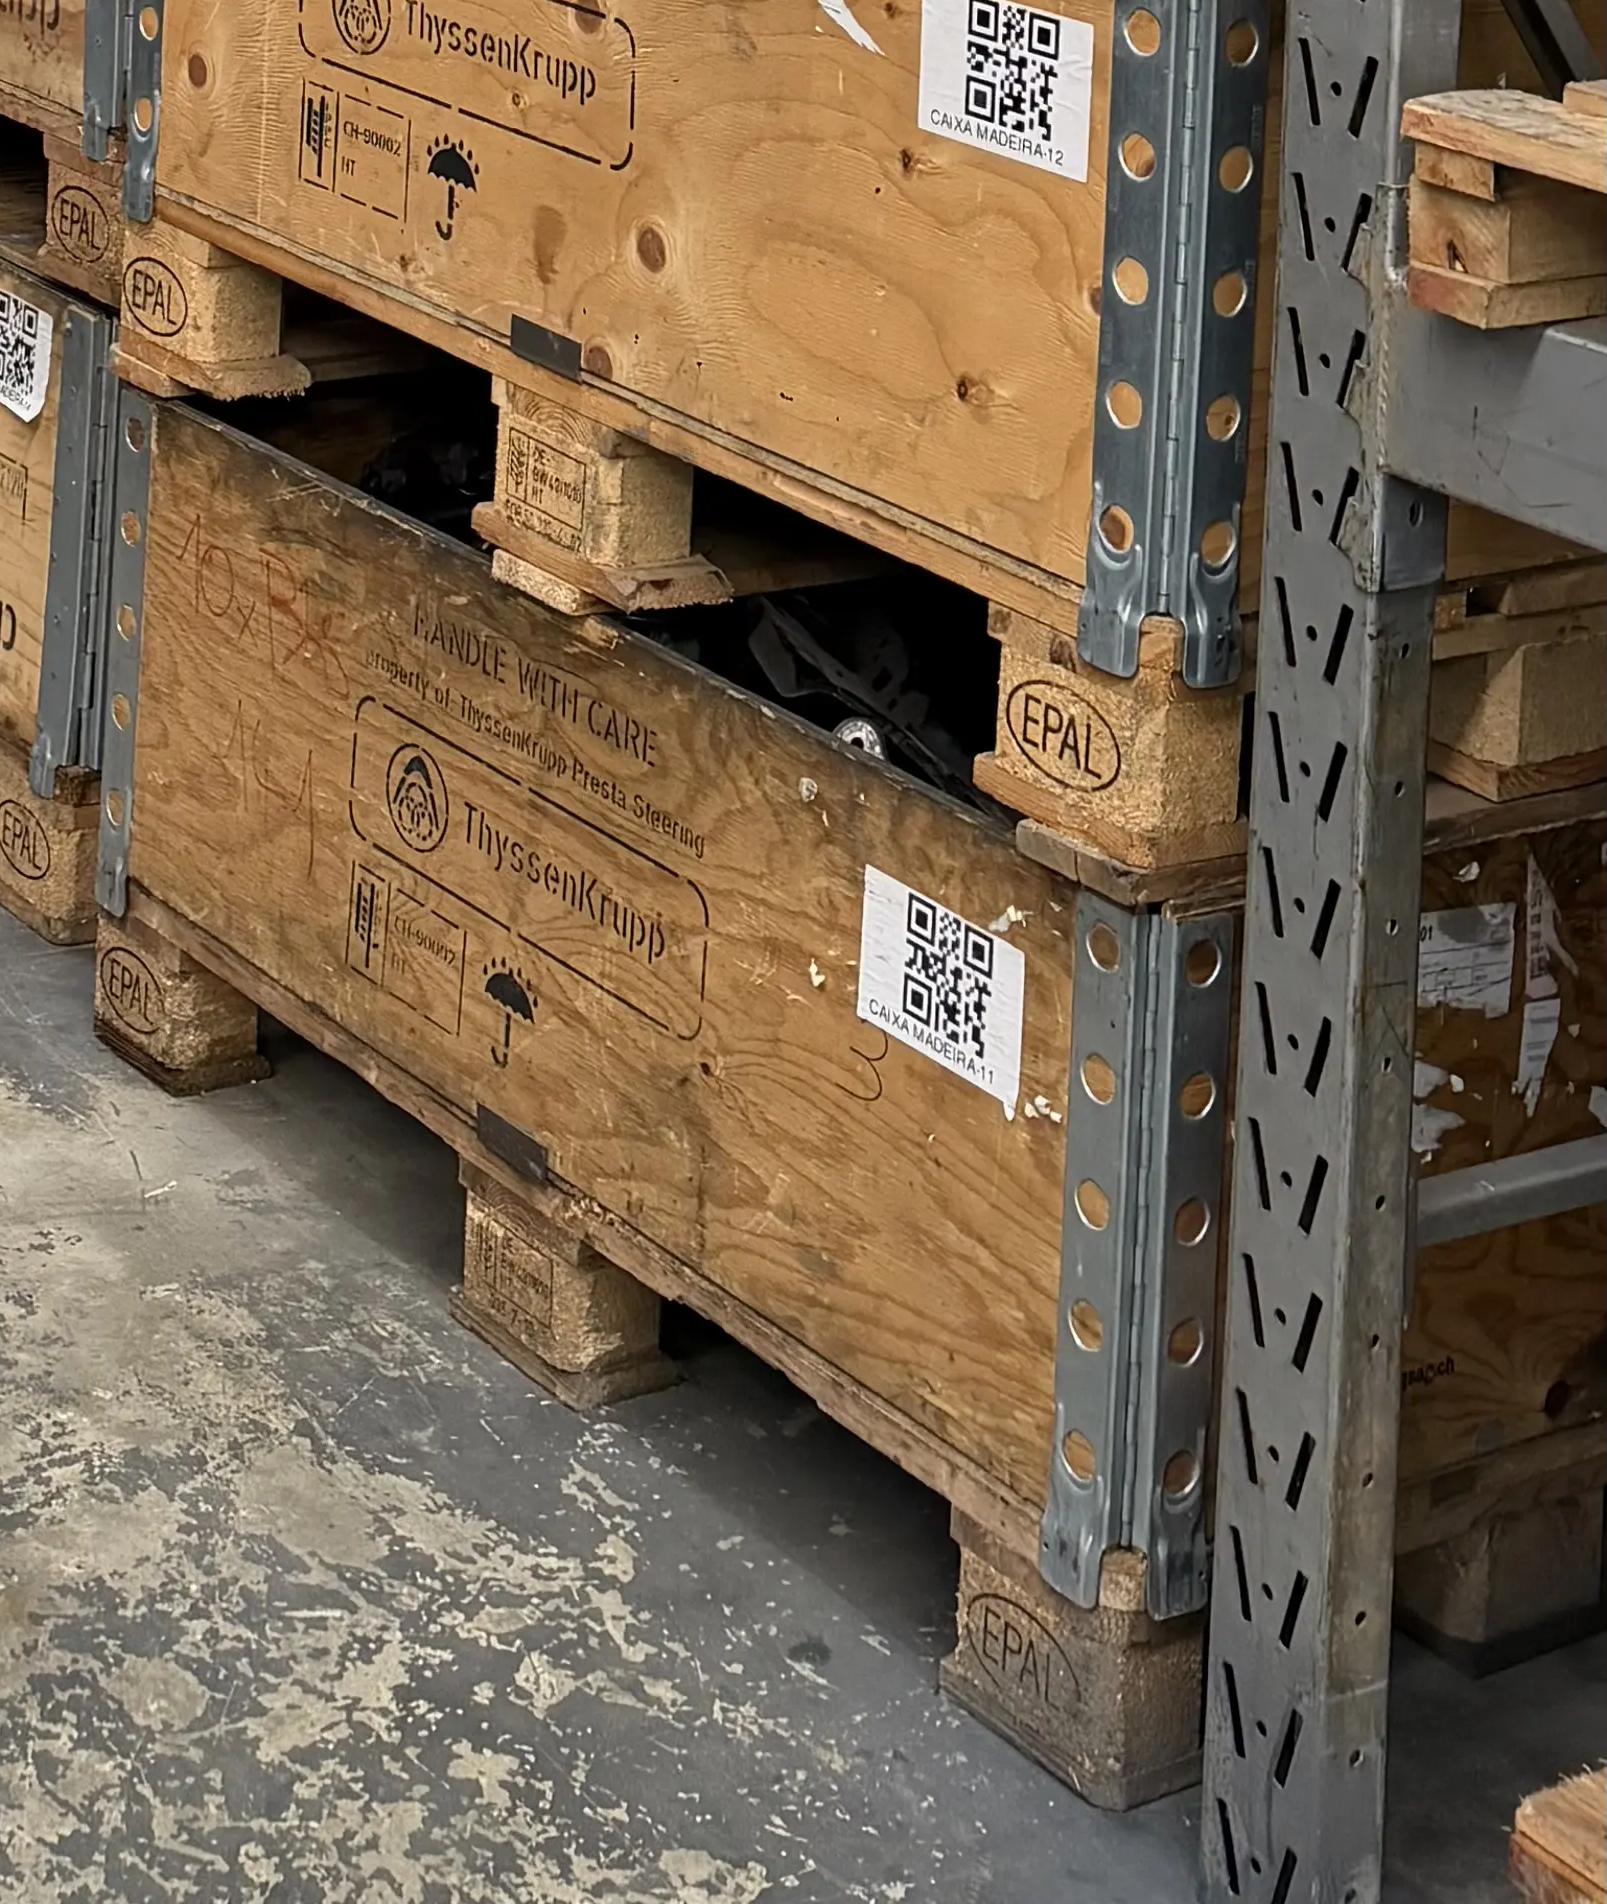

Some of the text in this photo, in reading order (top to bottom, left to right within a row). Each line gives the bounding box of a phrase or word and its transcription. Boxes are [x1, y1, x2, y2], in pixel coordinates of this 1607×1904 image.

[340, 154, 357, 178] HT
[342, 119, 402, 158] CH-90002
[930, 108, 1065, 167] CAIXA MADEIRA-12
[59, 199, 101, 252] EPAL
[132, 267, 178, 326] EPAL
[412, 614, 508, 685] HANDLE
[517, 656, 580, 725] WITH
[586, 699, 658, 769] CARE
[363, 651, 429, 705] property
[459, 691, 567, 780] ThyssenKrupp
[572, 757, 628, 812] Presta
[633, 793, 707, 860] Steering
[1022, 692, 1102, 780] EPAL
[2, 809, 42, 872] EPAL
[464, 801, 667, 964] ThyssenKrupp
[109, 957, 154, 1026] EPAL
[868, 997, 995, 1085] CAIXA MADEIRA-11
[982, 1604, 1058, 1713] EPAL
